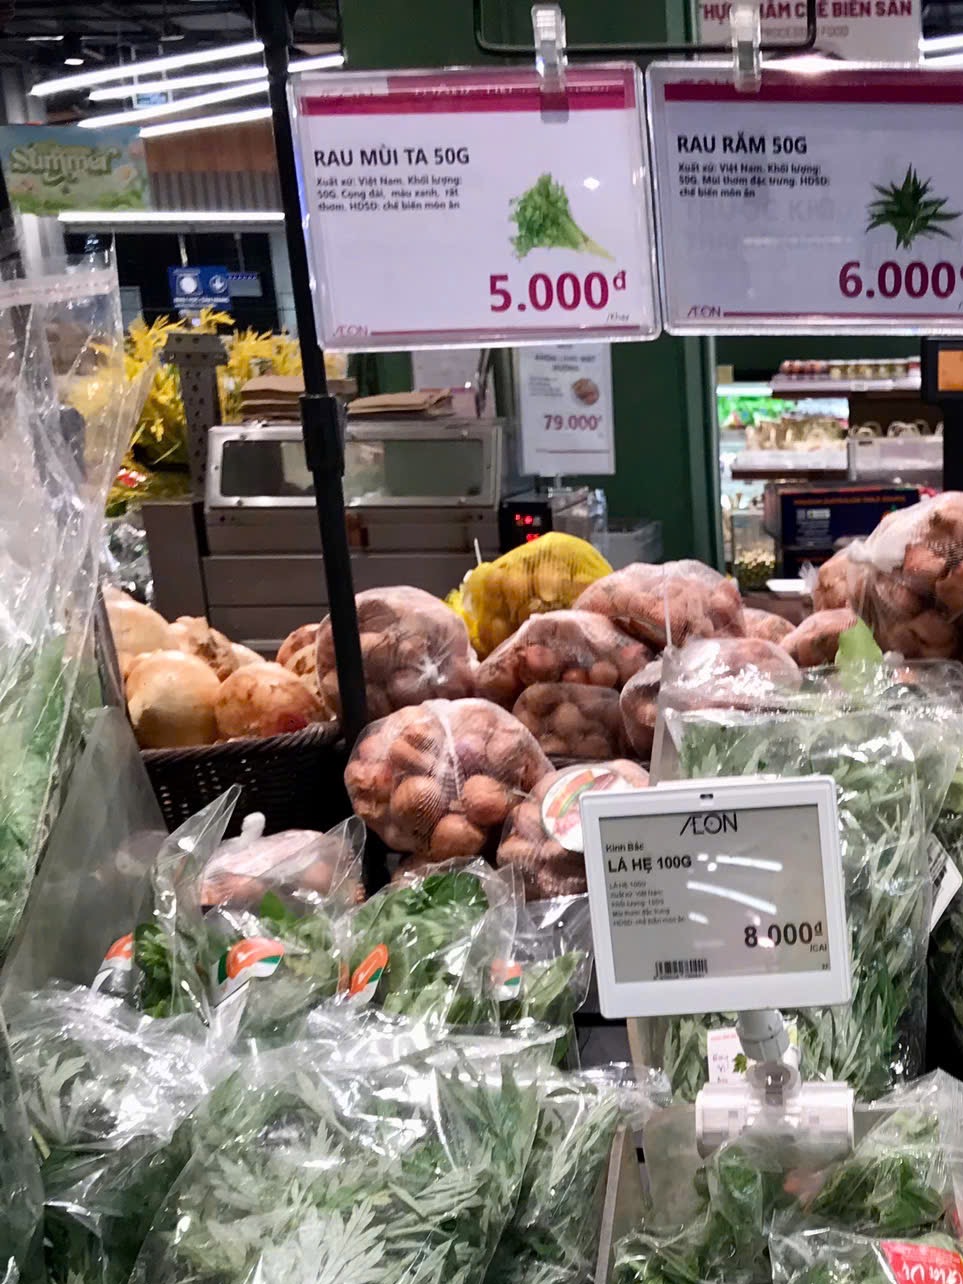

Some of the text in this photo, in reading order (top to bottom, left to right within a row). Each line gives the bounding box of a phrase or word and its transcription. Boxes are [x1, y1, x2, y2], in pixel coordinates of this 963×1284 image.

[677, 130, 808, 155] RAU RĂM 50G
[314, 150, 353, 167] RAU
[404, 148, 428, 165] TA
[434, 147, 470, 165] 50G
[608, 855, 692, 874] LÁ HẸ 100G
